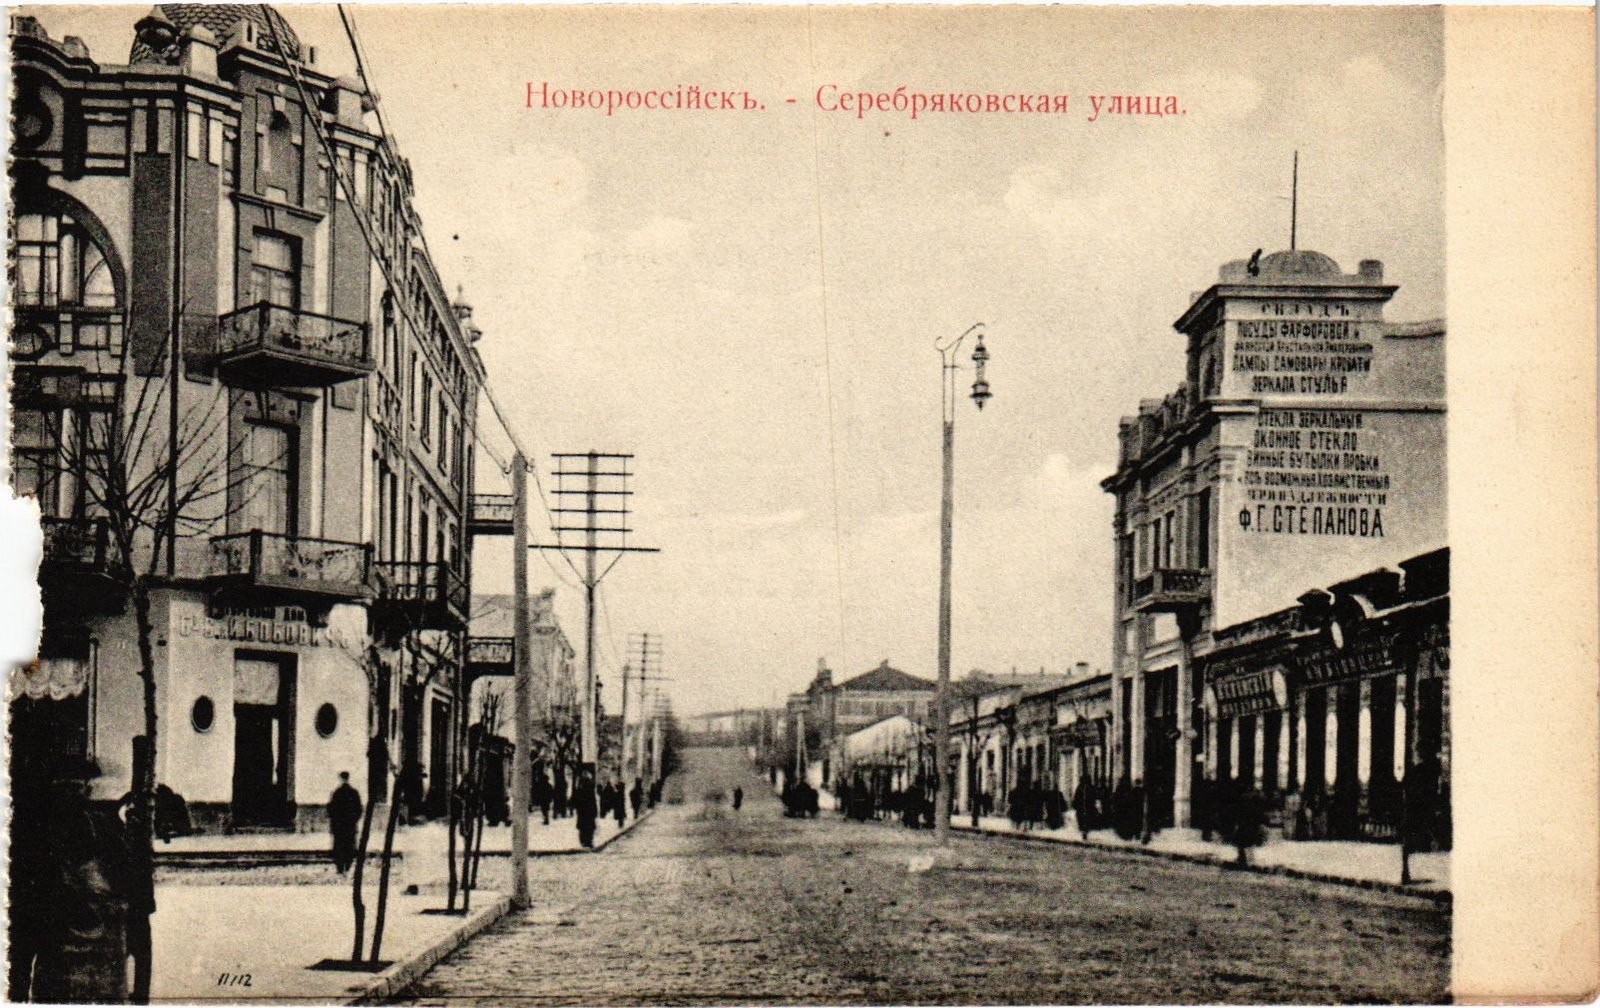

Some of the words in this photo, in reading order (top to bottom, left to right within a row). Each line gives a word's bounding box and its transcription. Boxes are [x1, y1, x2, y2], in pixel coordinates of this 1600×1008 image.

[1252, 376, 1295, 392] ЗЕРКАЛА
[1254, 429, 1301, 449] ОКОННОЕ
[1309, 431, 1358, 450] СТЕКЛО
